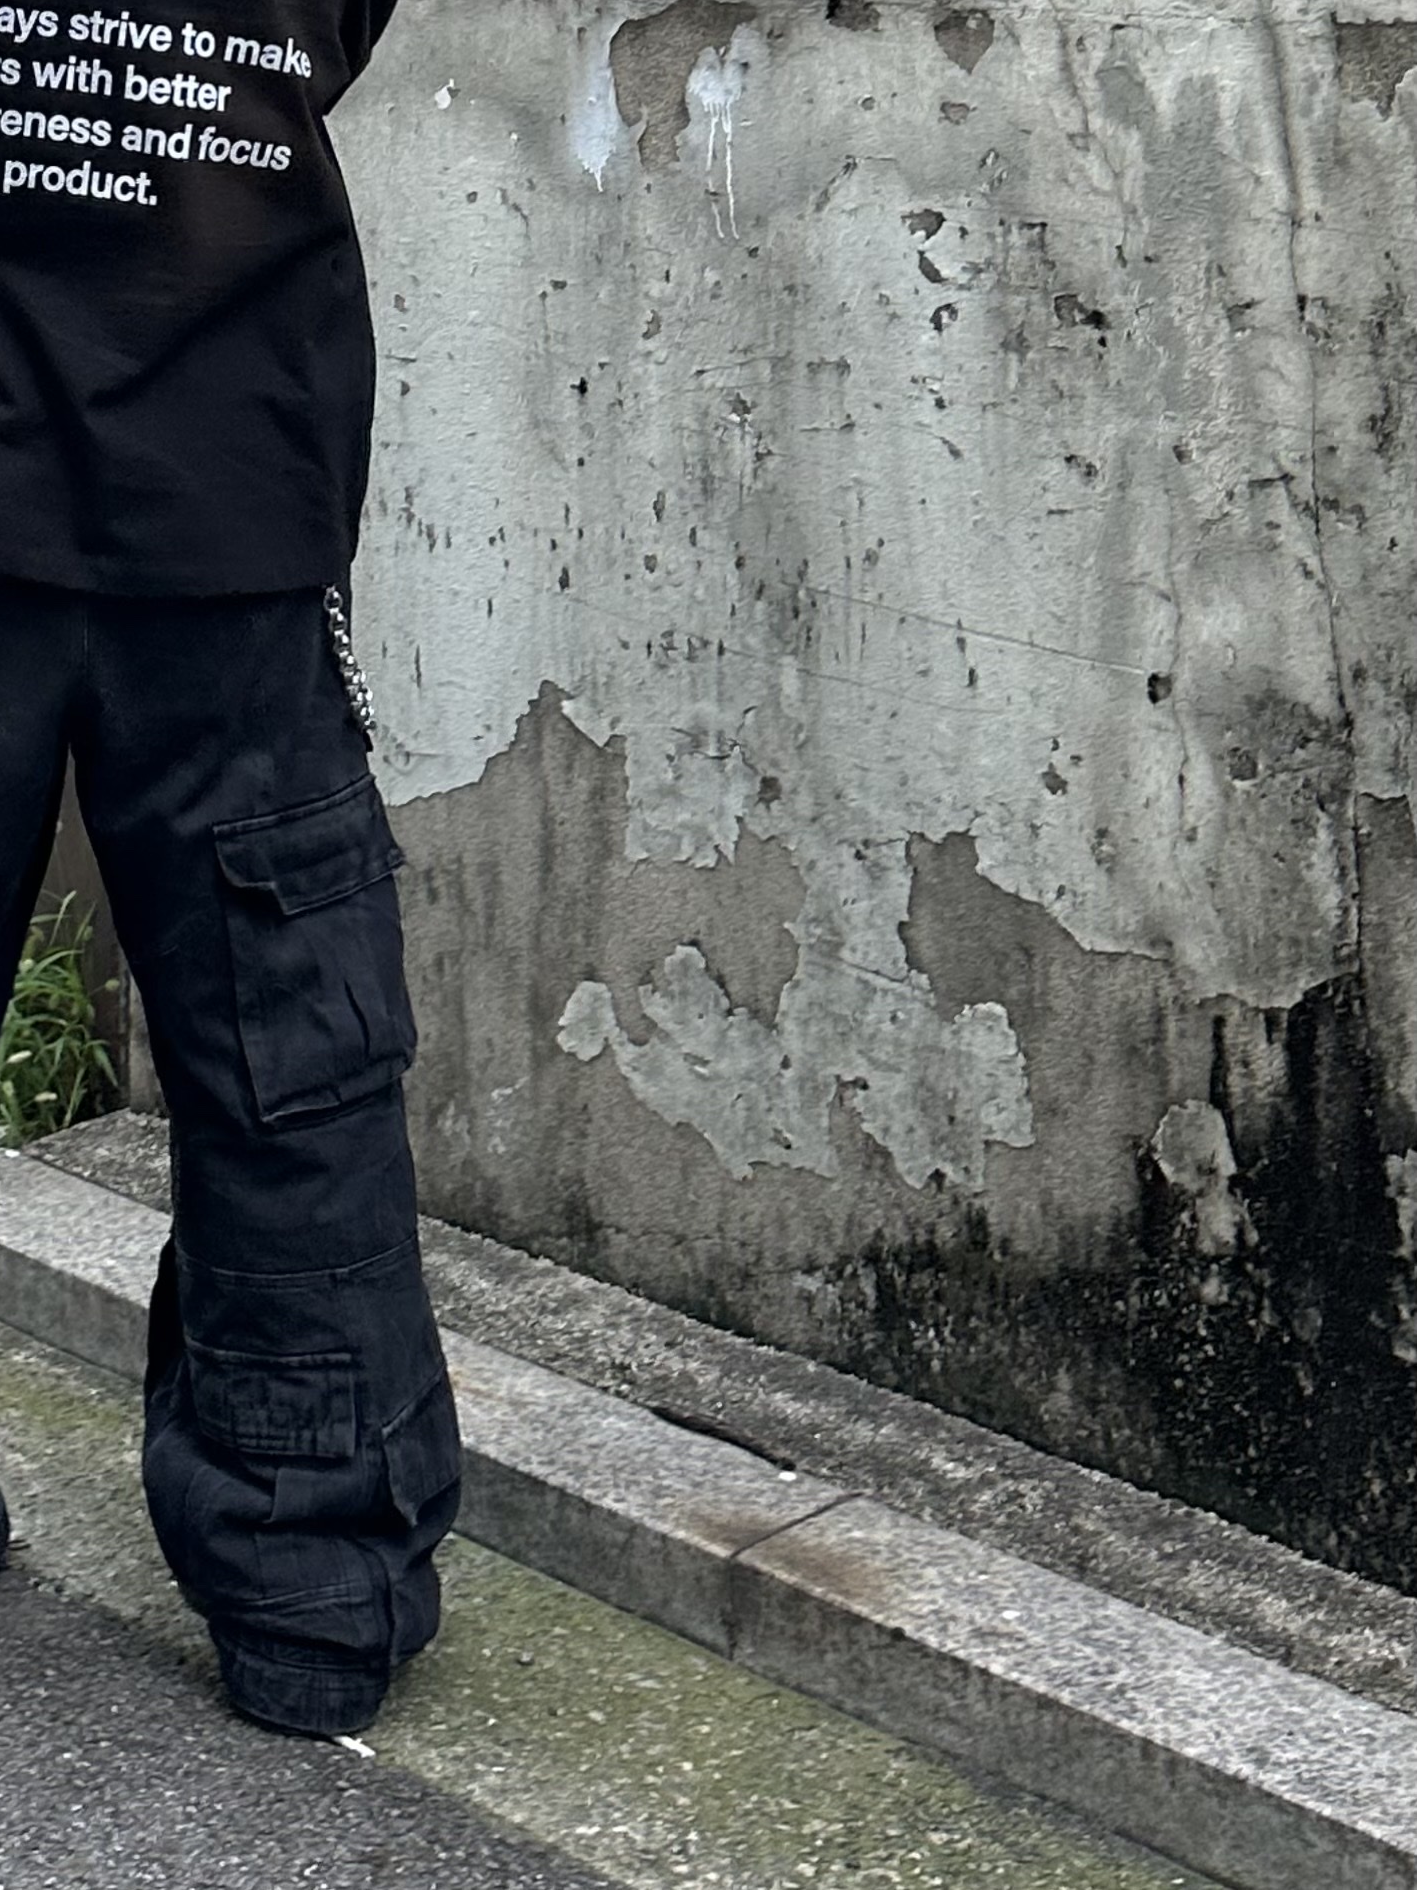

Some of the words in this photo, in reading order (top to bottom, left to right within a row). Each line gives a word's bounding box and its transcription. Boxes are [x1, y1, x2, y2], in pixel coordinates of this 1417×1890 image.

[68, 10, 173, 52] strive
[181, 22, 216, 58] to
[223, 35, 313, 80] make
[32, 55, 113, 97] with
[124, 64, 232, 112] better
[120, 123, 194, 161] and
[197, 125, 293, 171] focus
[2, 160, 158, 207] product.
